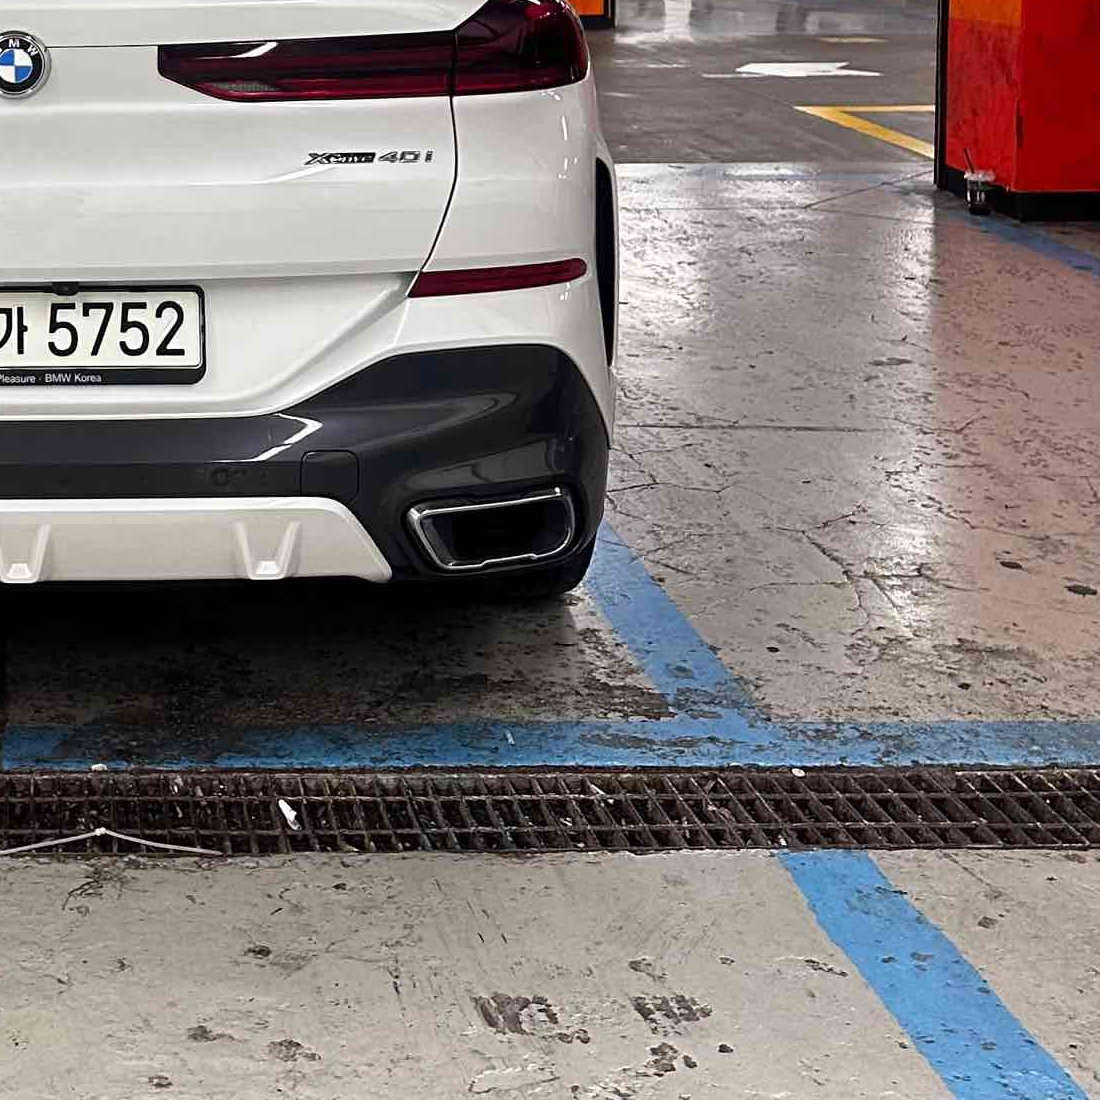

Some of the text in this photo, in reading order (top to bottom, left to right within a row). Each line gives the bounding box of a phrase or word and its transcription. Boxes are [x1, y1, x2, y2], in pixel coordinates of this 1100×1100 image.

[47, 300, 186, 358] 5752
[44, 373, 72, 383] BMW
[74, 372, 102, 383] Korea
